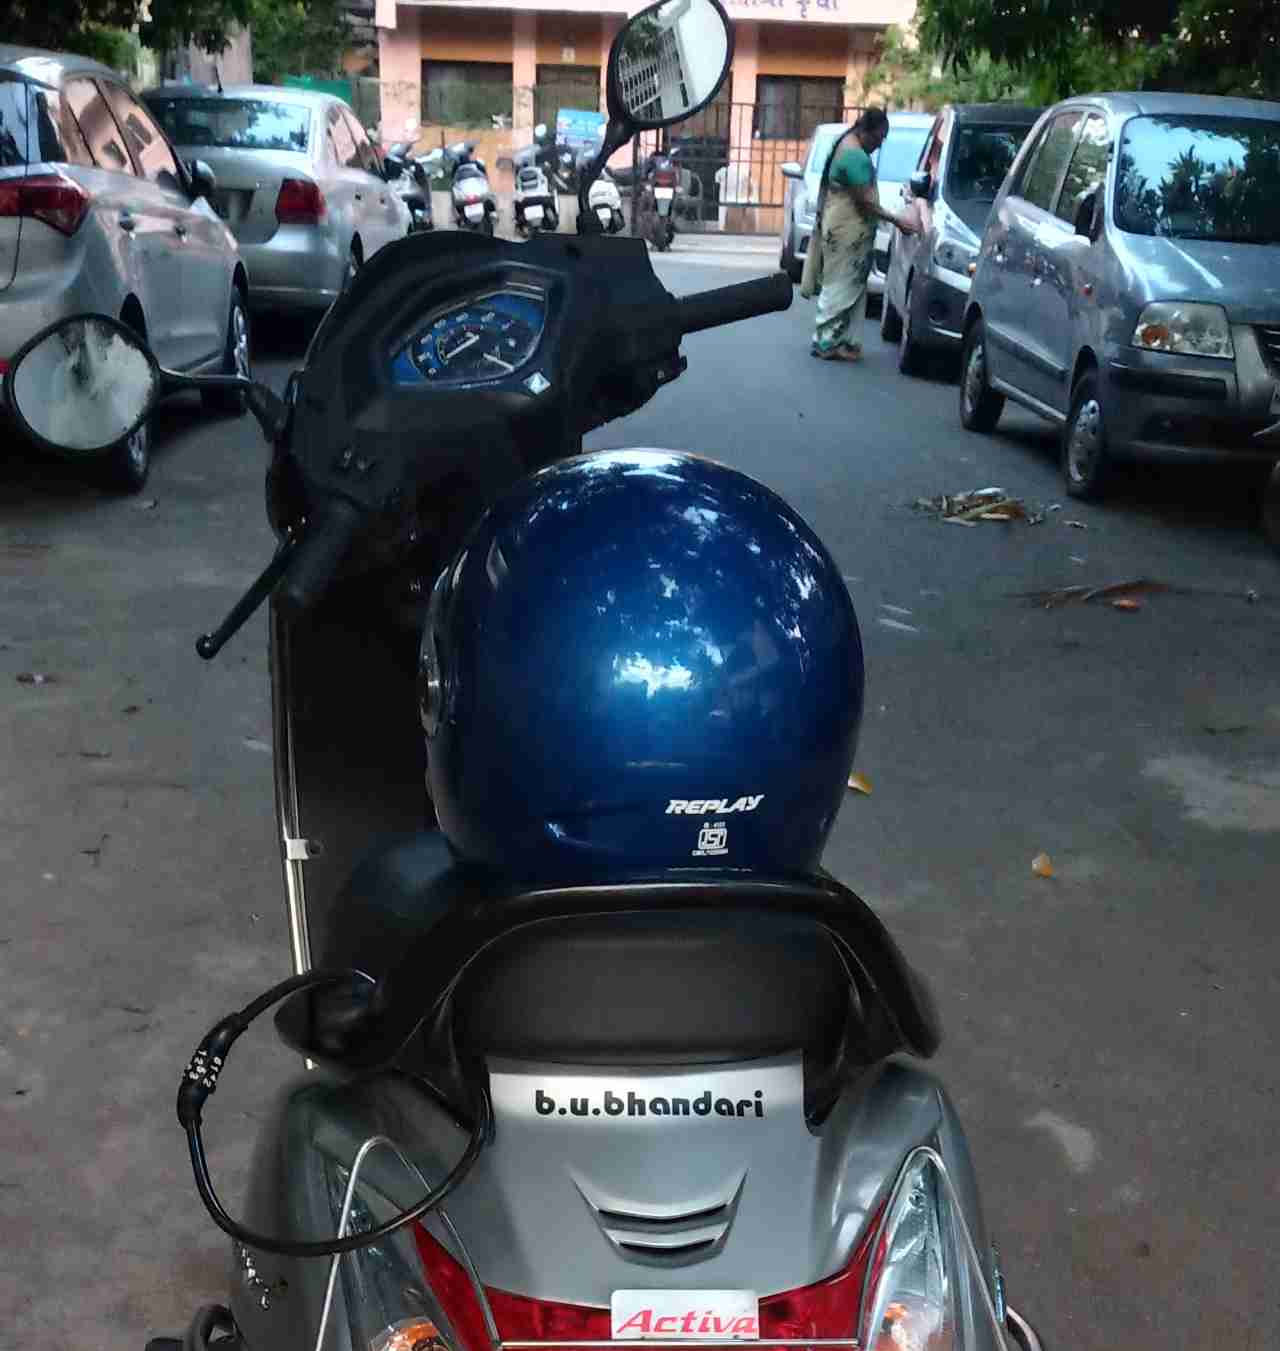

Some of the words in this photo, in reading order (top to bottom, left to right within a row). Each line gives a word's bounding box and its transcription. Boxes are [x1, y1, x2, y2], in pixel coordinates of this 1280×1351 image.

[664, 794, 765, 815] REPLAY
[535, 1089, 764, 1119] b.u.bhandari
[616, 1309, 758, 1334] Activa
